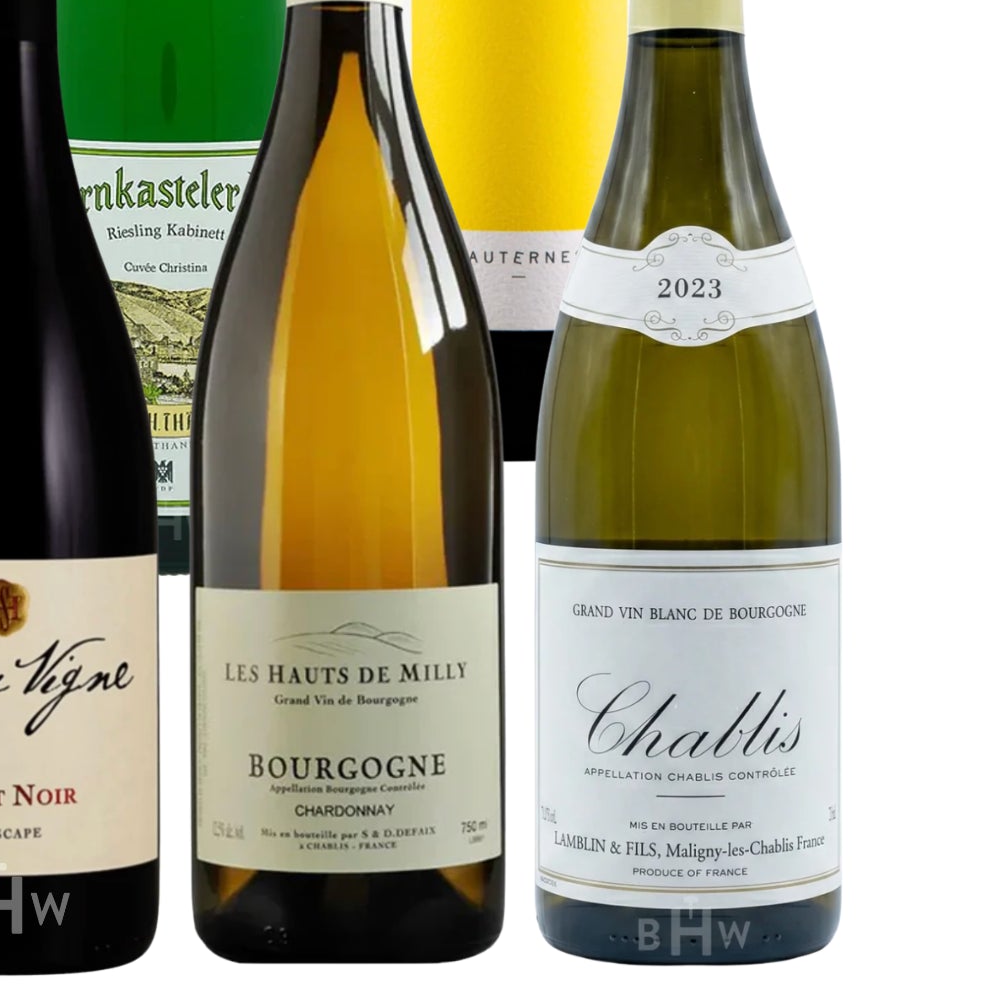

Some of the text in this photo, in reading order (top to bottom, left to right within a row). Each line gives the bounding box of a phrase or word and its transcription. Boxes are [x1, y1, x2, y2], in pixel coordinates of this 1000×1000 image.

[107, 223, 225, 241] Riesling Kabinett
[124, 262, 208, 273] Cuvée Christina
[657, 278, 722, 299] 2023
[573, 604, 807, 620] GRAND VIN BLANC DE BOURGOGNE
[224, 662, 468, 684] LES HAUTS DE MILLY
[15, 637, 135, 736] Vigne
[274, 694, 419, 707] Grand Vin de Bourgogne
[576, 673, 802, 758] Chablis
[249, 753, 446, 780] BOURGOGNE
[584, 767, 797, 782] APPELLATION CHABLIS CONTRÔLÉE
[269, 784, 323, 795] Appellation
[326, 785, 378, 796] Bourgogne
[294, 804, 395, 817] CHARDONNAY
[629, 820, 752, 831] MIS EN BOUTEILLE PAR
[260, 828, 277, 837] Mis
[280, 831, 291, 839] en
[294, 829, 338, 840] bouteille
[341, 832, 358, 841] par
[362, 830, 368, 838] S
[371, 830, 379, 838] &
[306, 842, 349, 850] CHABLIS
[359, 842, 398, 850] FRANCE
[554, 830, 825, 862] LAMBLIN & FILS, Maligny-les-Chablis France
[633, 867, 748, 877] PRODUCE OF FRANCE
